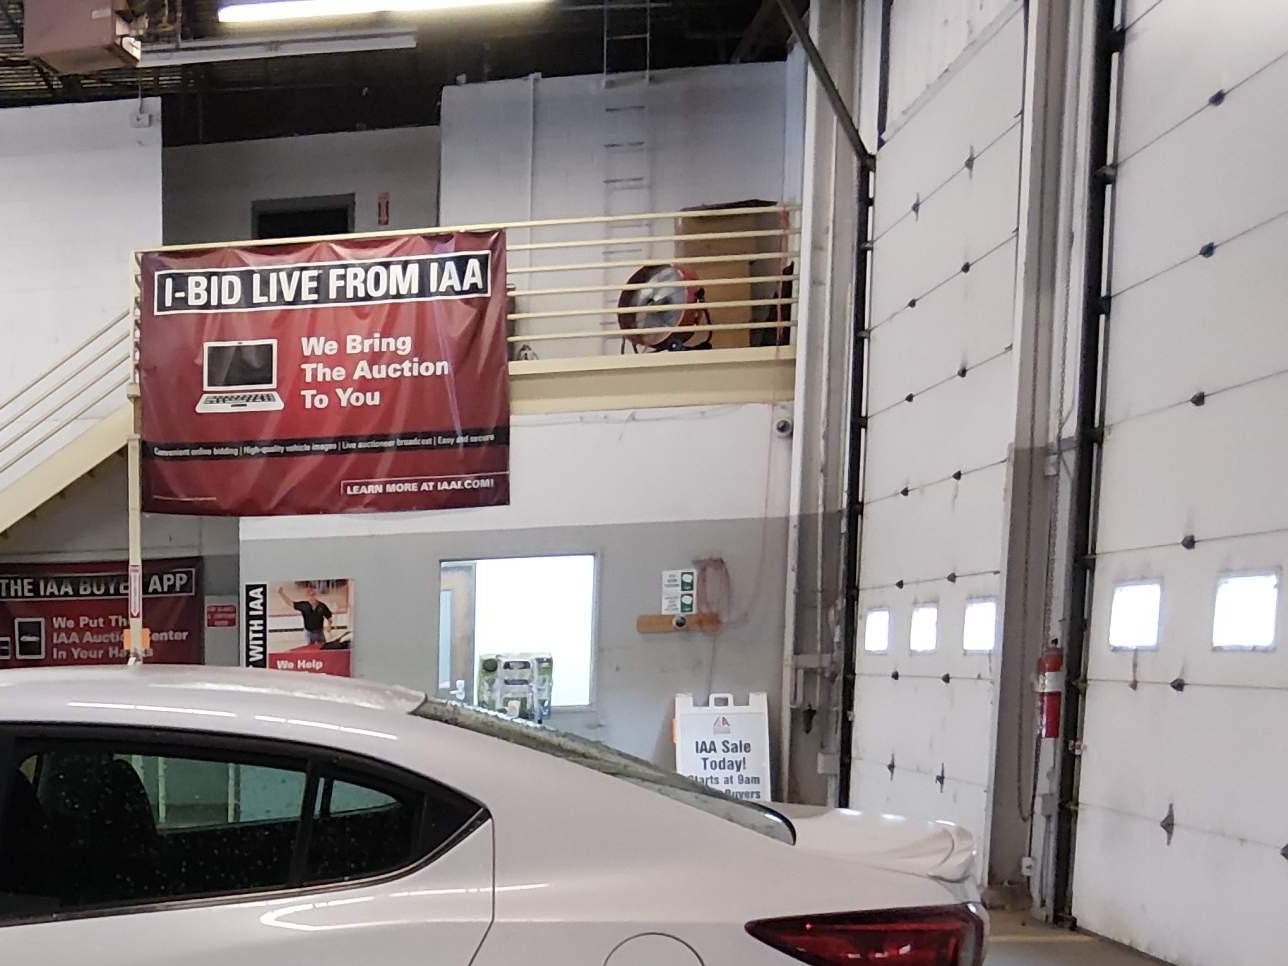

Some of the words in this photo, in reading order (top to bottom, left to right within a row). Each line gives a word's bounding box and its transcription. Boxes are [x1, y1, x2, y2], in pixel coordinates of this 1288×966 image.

[164, 275, 242, 308] I-BID
[252, 269, 320, 304] LIVE
[328, 263, 420, 300] FROM
[429, 258, 483, 293] IAA
[300, 336, 339, 356] We
[346, 333, 412, 355] Bring
[300, 363, 347, 383] The
[353, 357, 449, 380] Auction
[300, 389, 329, 409] To
[335, 387, 381, 407] You
[346, 484, 383, 496] LEARN
[385, 482, 419, 494] MORE
[420, 481, 435, 492] AT
[39, 577, 73, 596] IAA
[79, 575, 130, 595] BUYE
[147, 573, 188, 593] APP
[248, 586, 264, 615] IAA
[52, 616, 75, 629] We
[79, 615, 104, 628] Put
[52, 632, 80, 644] IAA
[82, 631, 125, 643] Aucti
[150, 629, 189, 641] enter
[248, 619, 264, 662] WITH
[52, 647, 67, 660] In
[71, 647, 105, 660] Your
[276, 659, 295, 669] We
[297, 658, 323, 671] Help
[695, 740, 717, 754] IAA
[721, 739, 751, 754] Sale
[701, 756, 746, 773] Today!
[723, 775, 734, 785] at
[737, 774, 760, 785] 9am
